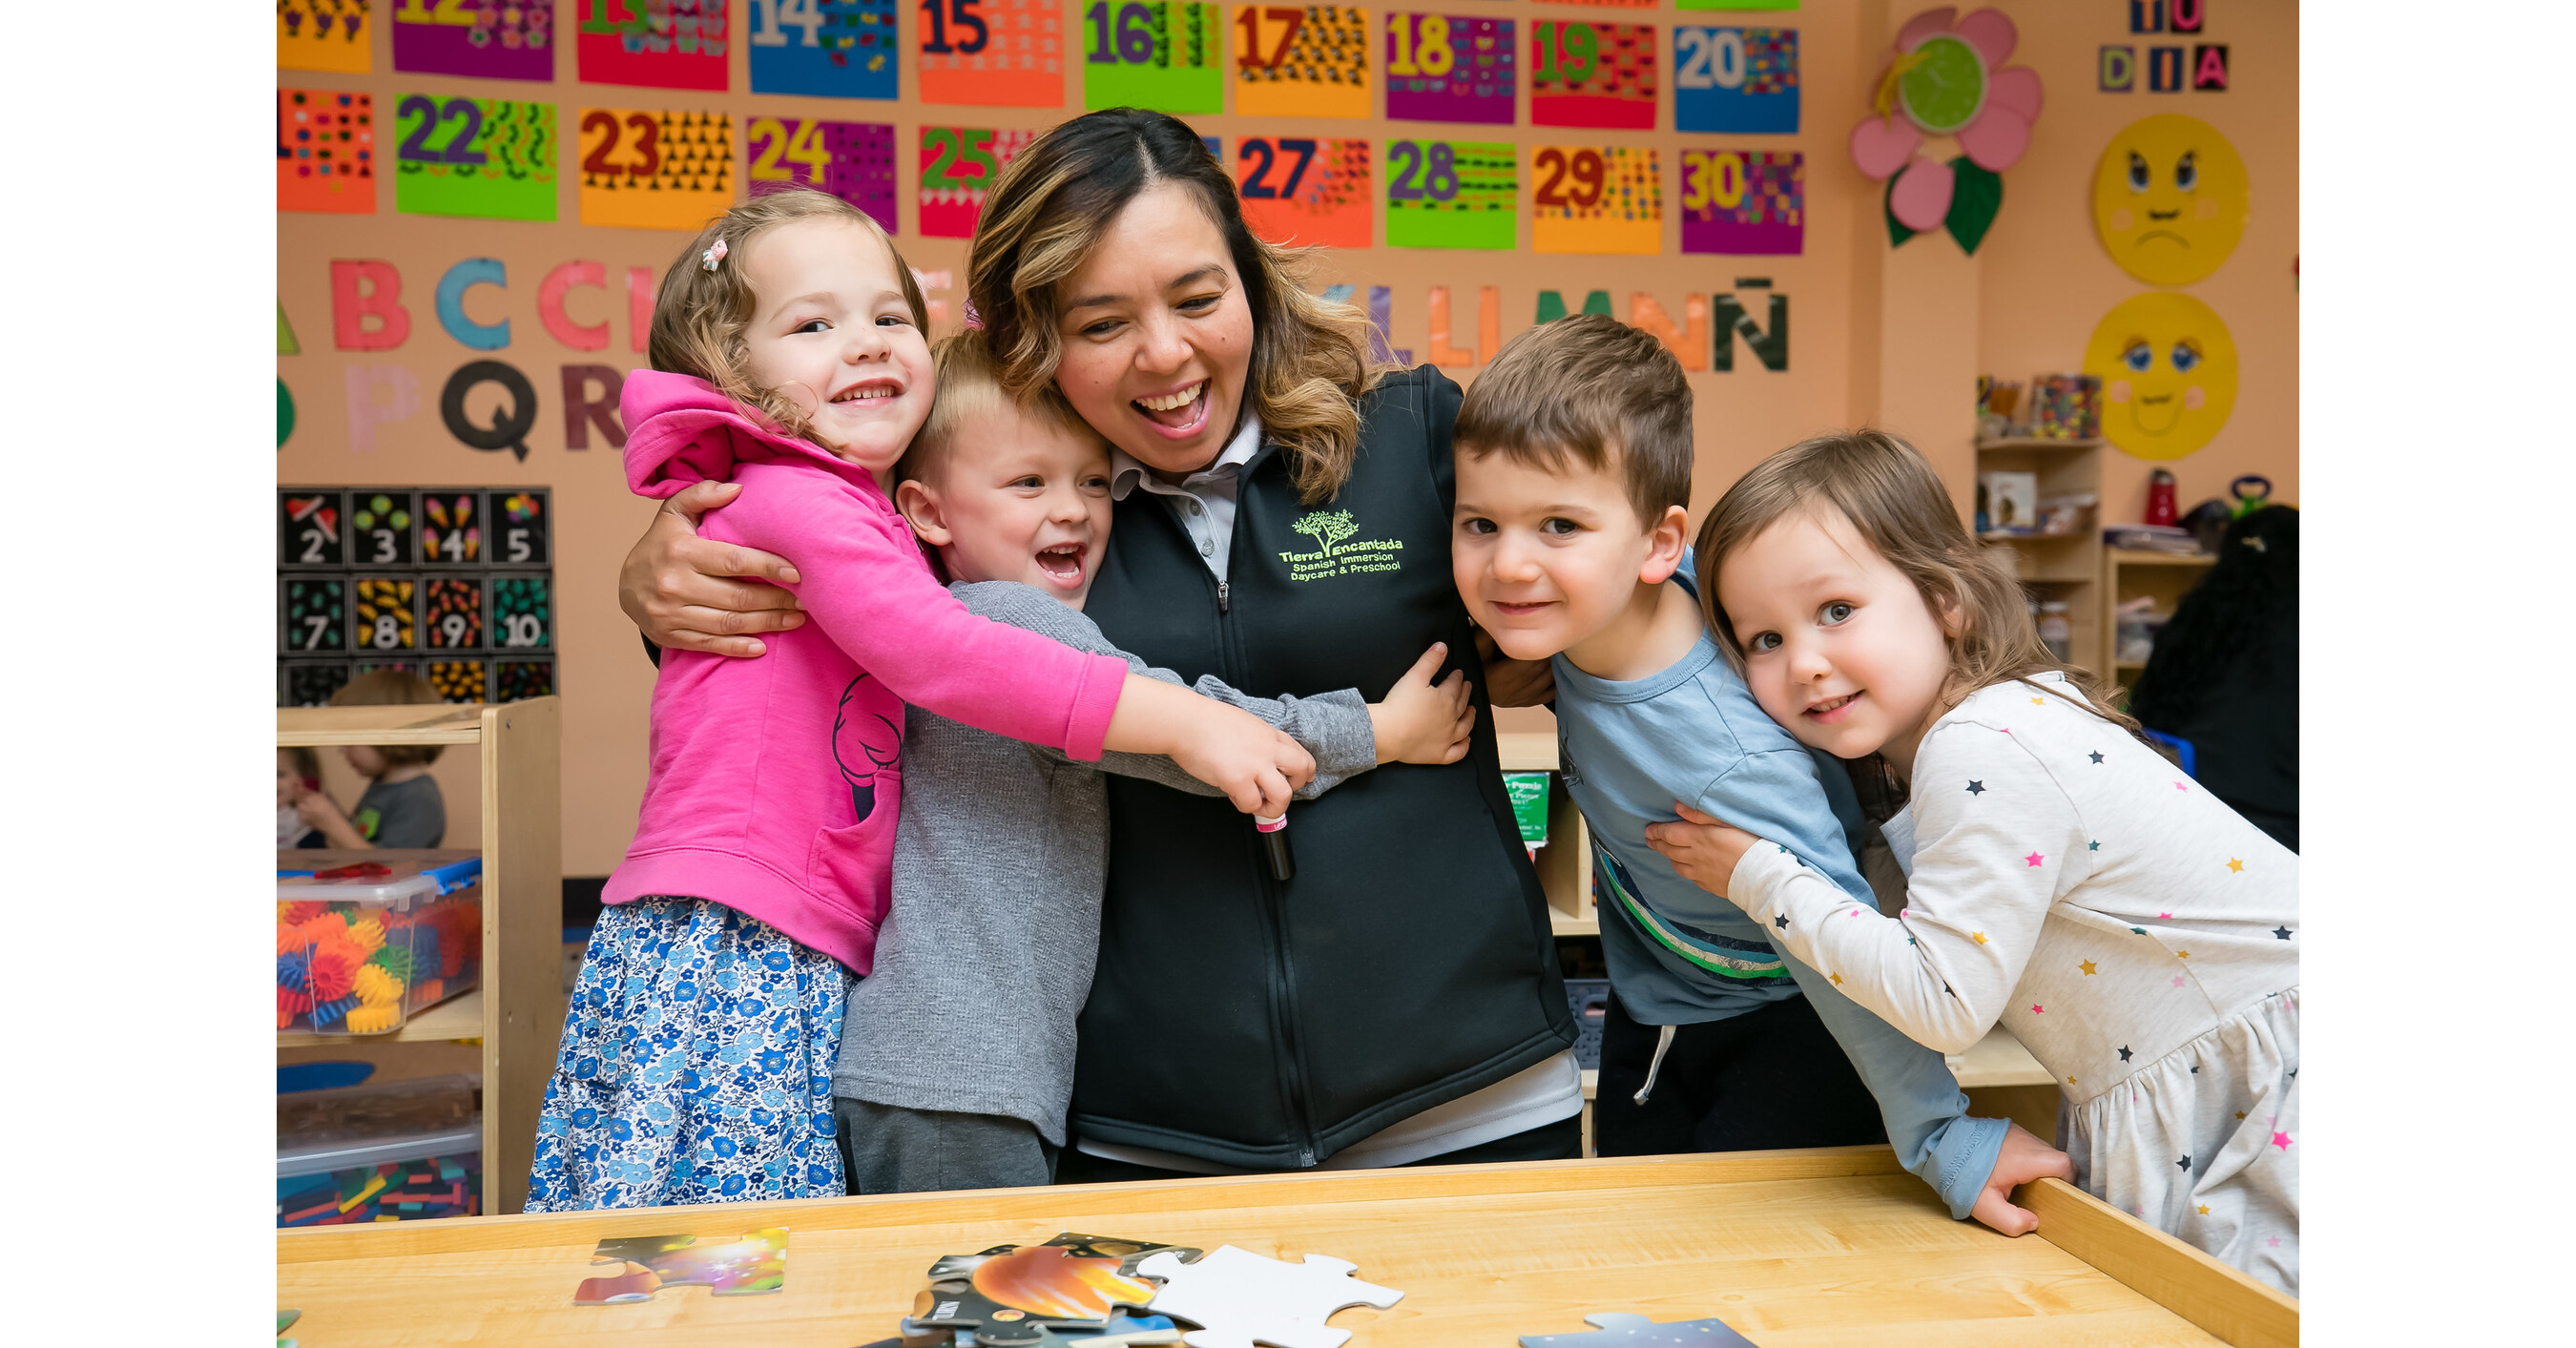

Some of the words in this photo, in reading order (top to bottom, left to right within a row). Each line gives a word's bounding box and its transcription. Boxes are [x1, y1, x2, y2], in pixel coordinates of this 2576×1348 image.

[751, 0, 823, 47] 14
[921, 0, 988, 53] 15
[1087, 1, 1154, 64] 16
[1237, 7, 1304, 68] 17
[1388, 13, 1455, 76] 18
[1532, 22, 1598, 83] 19
[1676, 30, 1746, 89] 20
[2103, 46, 2228, 90] DIA
[397, 96, 488, 164] 22
[581, 112, 660, 176] 23
[748, 118, 832, 184] 24
[922, 128, 997, 190] 25
[1240, 138, 1317, 199] 27
[1388, 141, 1460, 202] 28
[1534, 149, 1605, 207] 29
[1682, 153, 1744, 210] 30
[440, 359, 538, 464] Q
[300, 529, 325, 563] 2
[372, 529, 398, 563] 3
[441, 529, 466, 562] 4
[507, 529, 531, 562] 5
[1278, 551, 1323, 563] Tierra
[1332, 538, 1403, 556] Encantada
[1291, 569, 1336, 582] Daycare
[1339, 566, 1348, 575] &
[1350, 561, 1401, 573] Preschool
[1293, 559, 1336, 572] Spanish
[1340, 551, 1394, 565] Immersion
[304, 615, 329, 650] 7
[373, 614, 400, 649] 8
[442, 614, 467, 648] 9
[503, 613, 541, 647] 10
